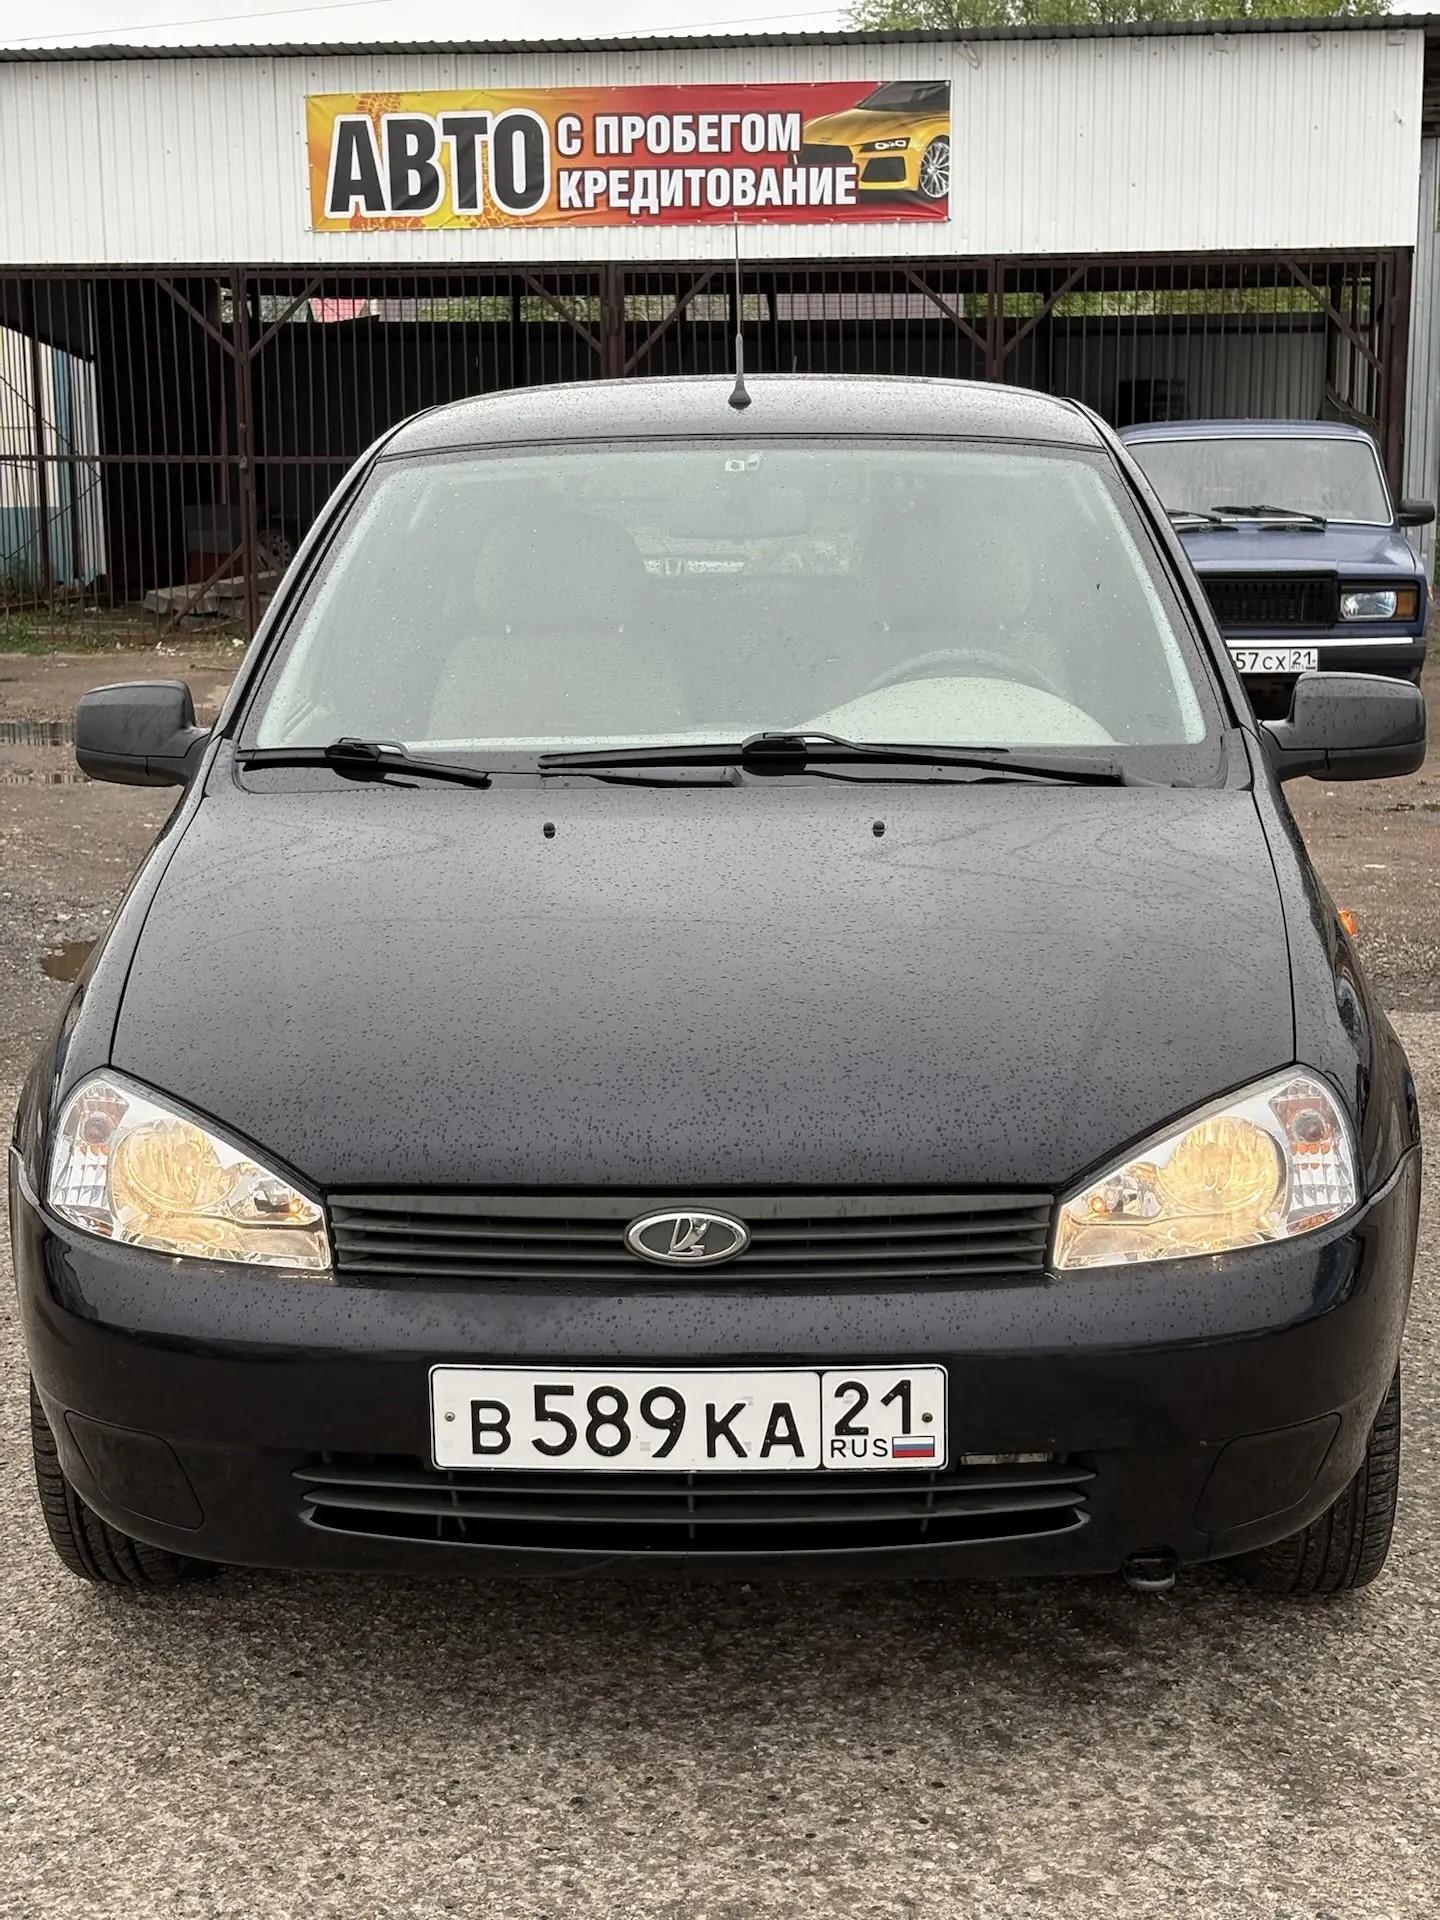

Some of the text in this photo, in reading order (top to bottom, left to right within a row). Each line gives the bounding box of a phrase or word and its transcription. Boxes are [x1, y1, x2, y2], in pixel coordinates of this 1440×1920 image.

[557, 113, 800, 155] С ПРОБЕГОМ
[329, 112, 547, 213] АВТО
[559, 166, 857, 214] КРЕДИТОВАНИЕ
[1292, 651, 1311, 665] 21
[834, 1379, 911, 1436] 21
[830, 1438, 888, 1459] RUS
